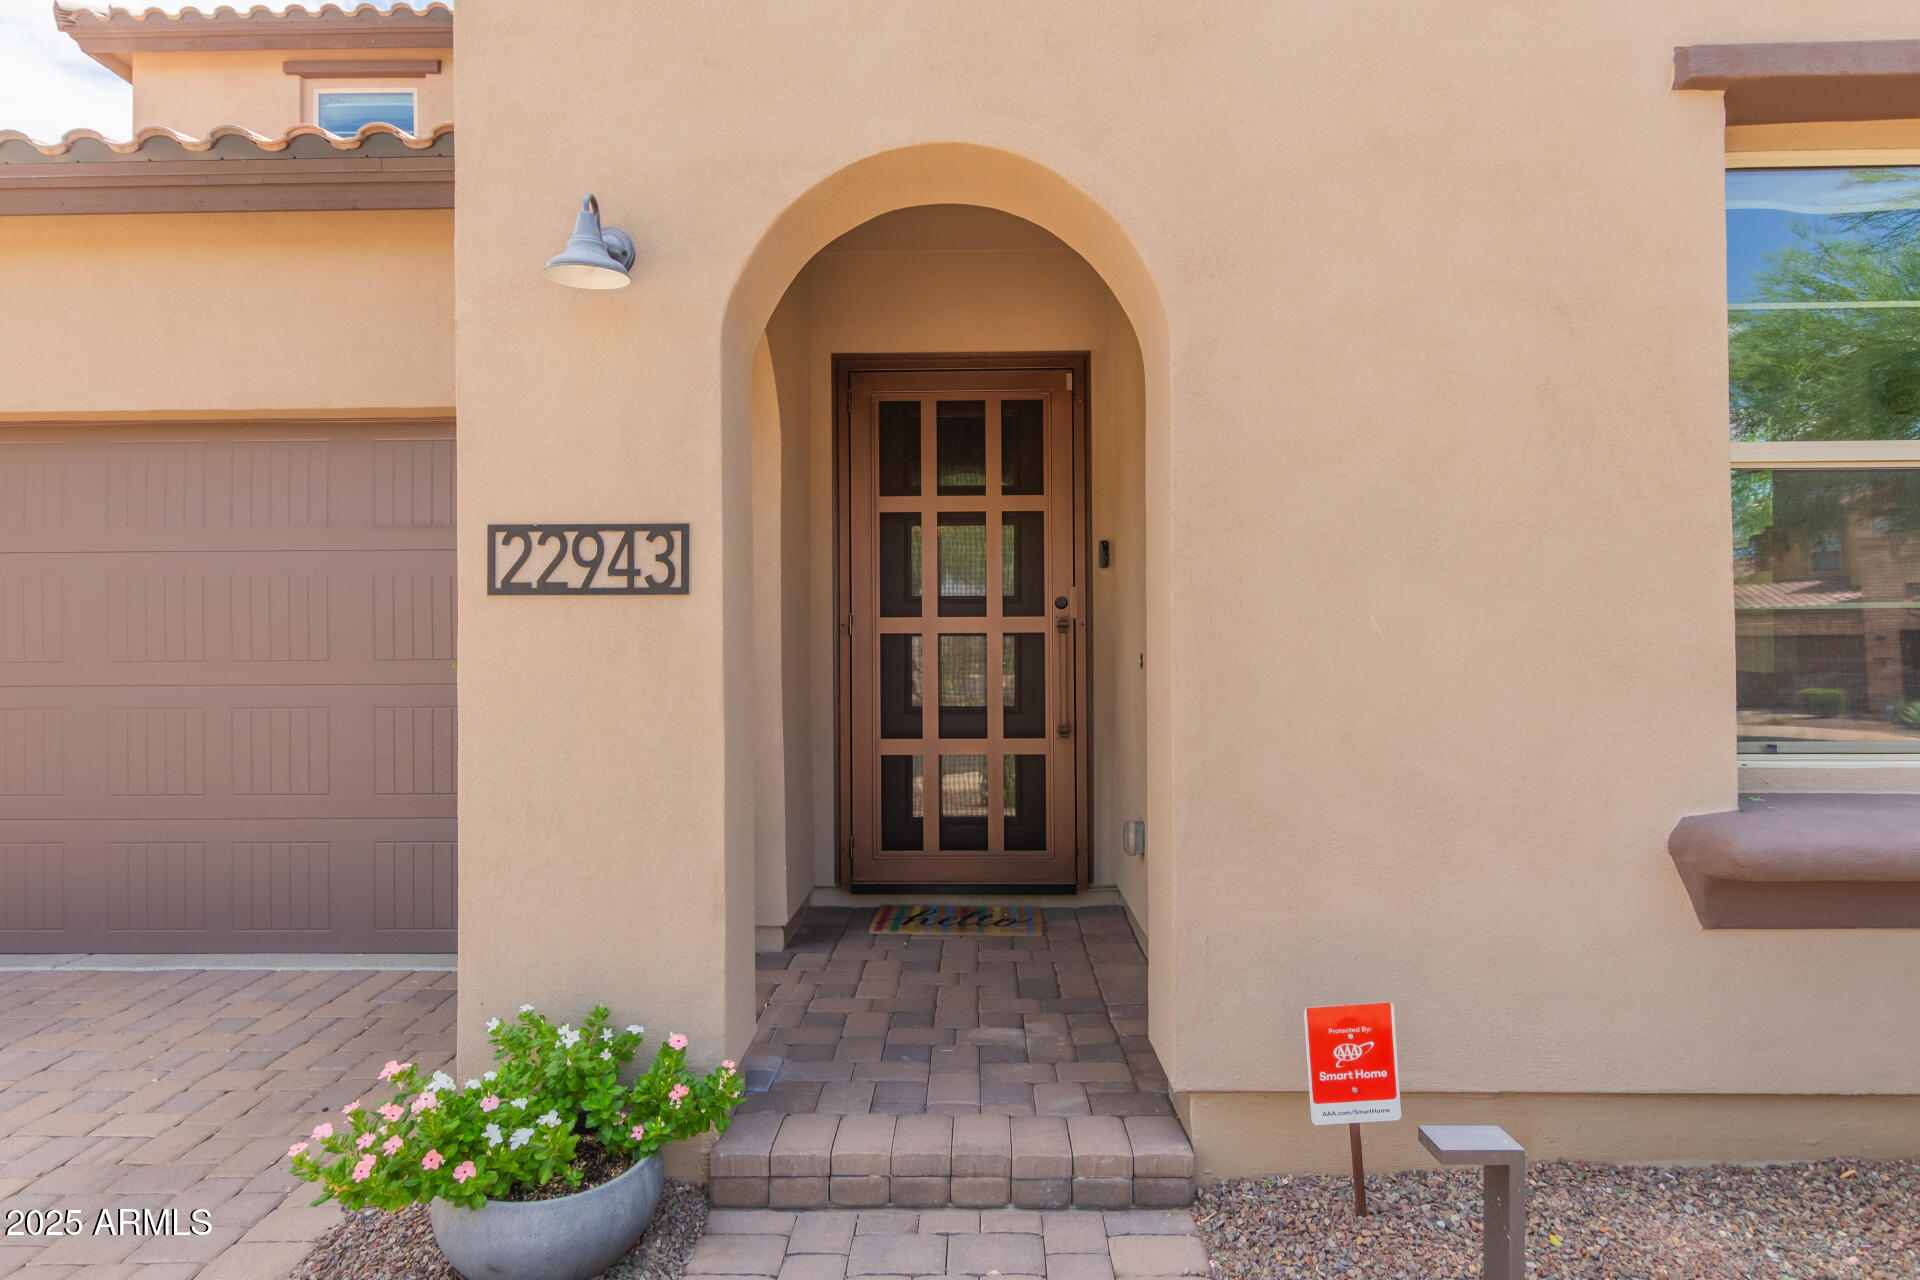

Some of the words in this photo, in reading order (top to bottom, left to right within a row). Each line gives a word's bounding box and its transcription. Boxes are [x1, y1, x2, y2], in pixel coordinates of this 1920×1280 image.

[501, 531, 676, 589] 22943
[876, 909, 1033, 927] hello
[1338, 1044, 1359, 1061] AAA
[1319, 1071, 1353, 1081] Smart
[1355, 1069, 1388, 1079] Home
[1322, 1108, 1390, 1117] AAA.com/SmartHome
